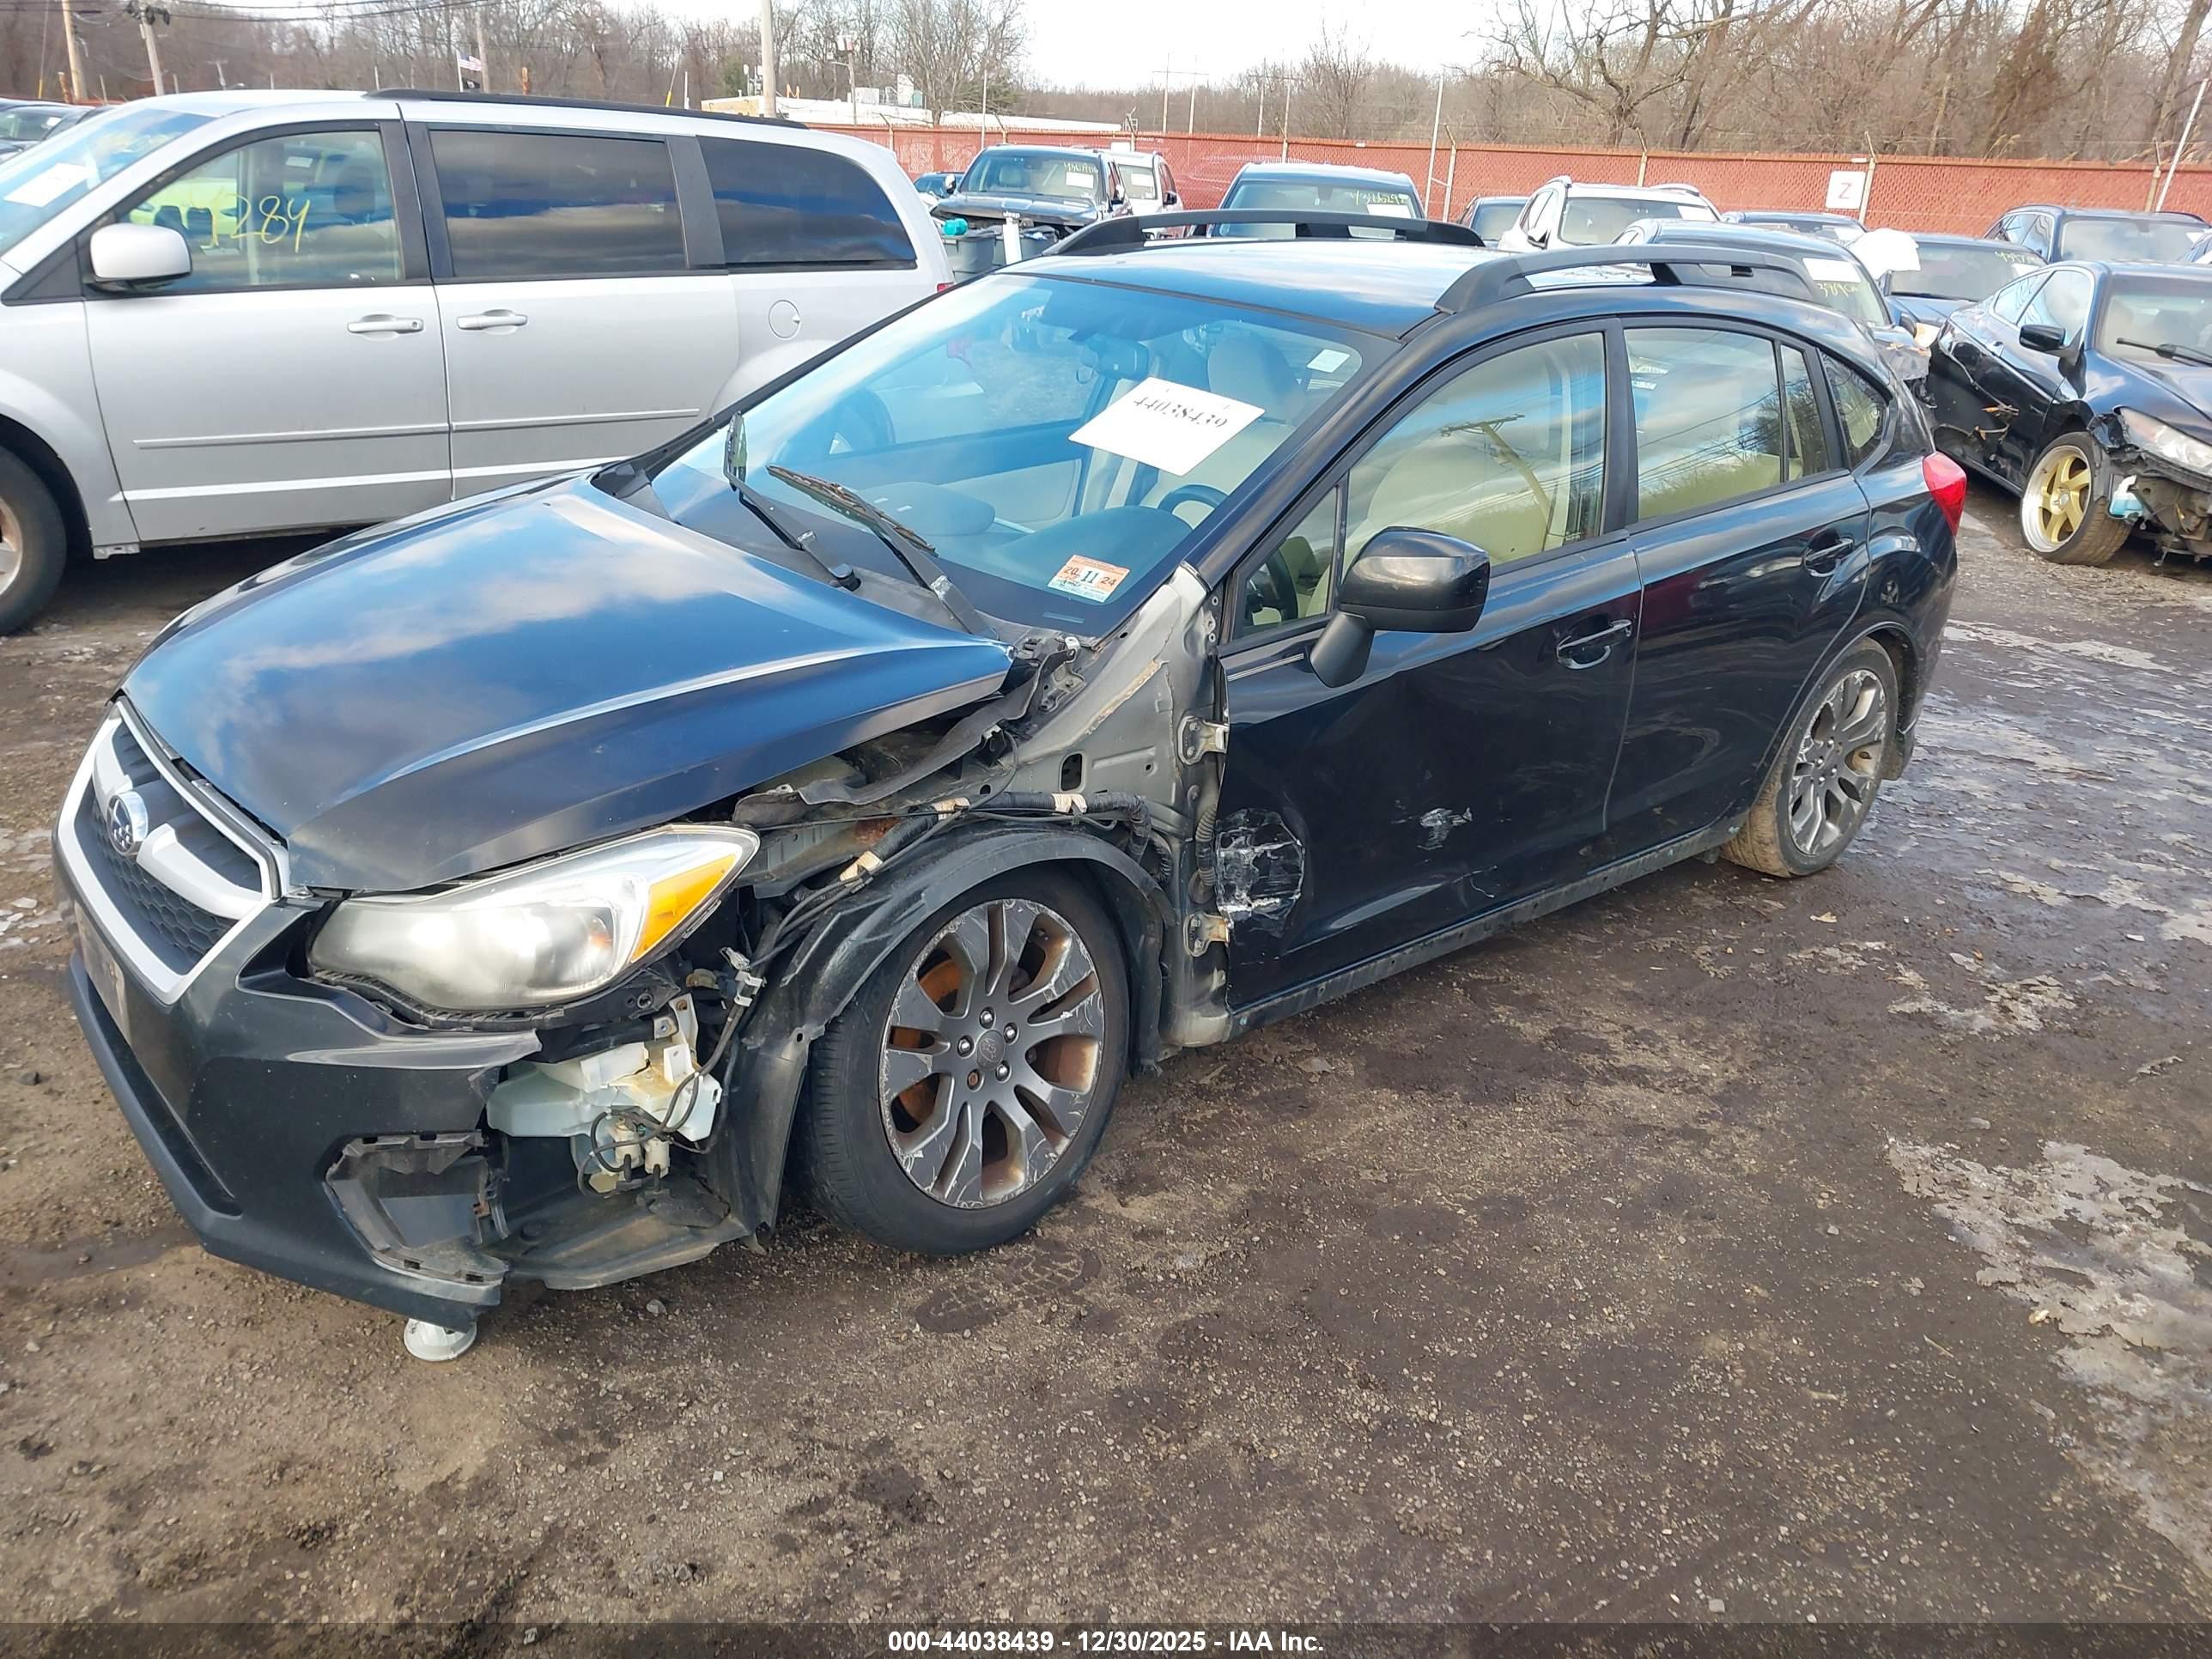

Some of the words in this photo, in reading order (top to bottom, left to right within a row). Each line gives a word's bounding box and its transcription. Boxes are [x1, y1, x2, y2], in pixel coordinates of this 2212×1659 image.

[1838, 182, 1852, 199] Z
[1133, 396, 1229, 428] 44038439
[1080, 570, 1100, 584] 11
[1100, 576, 1117, 586] 24
